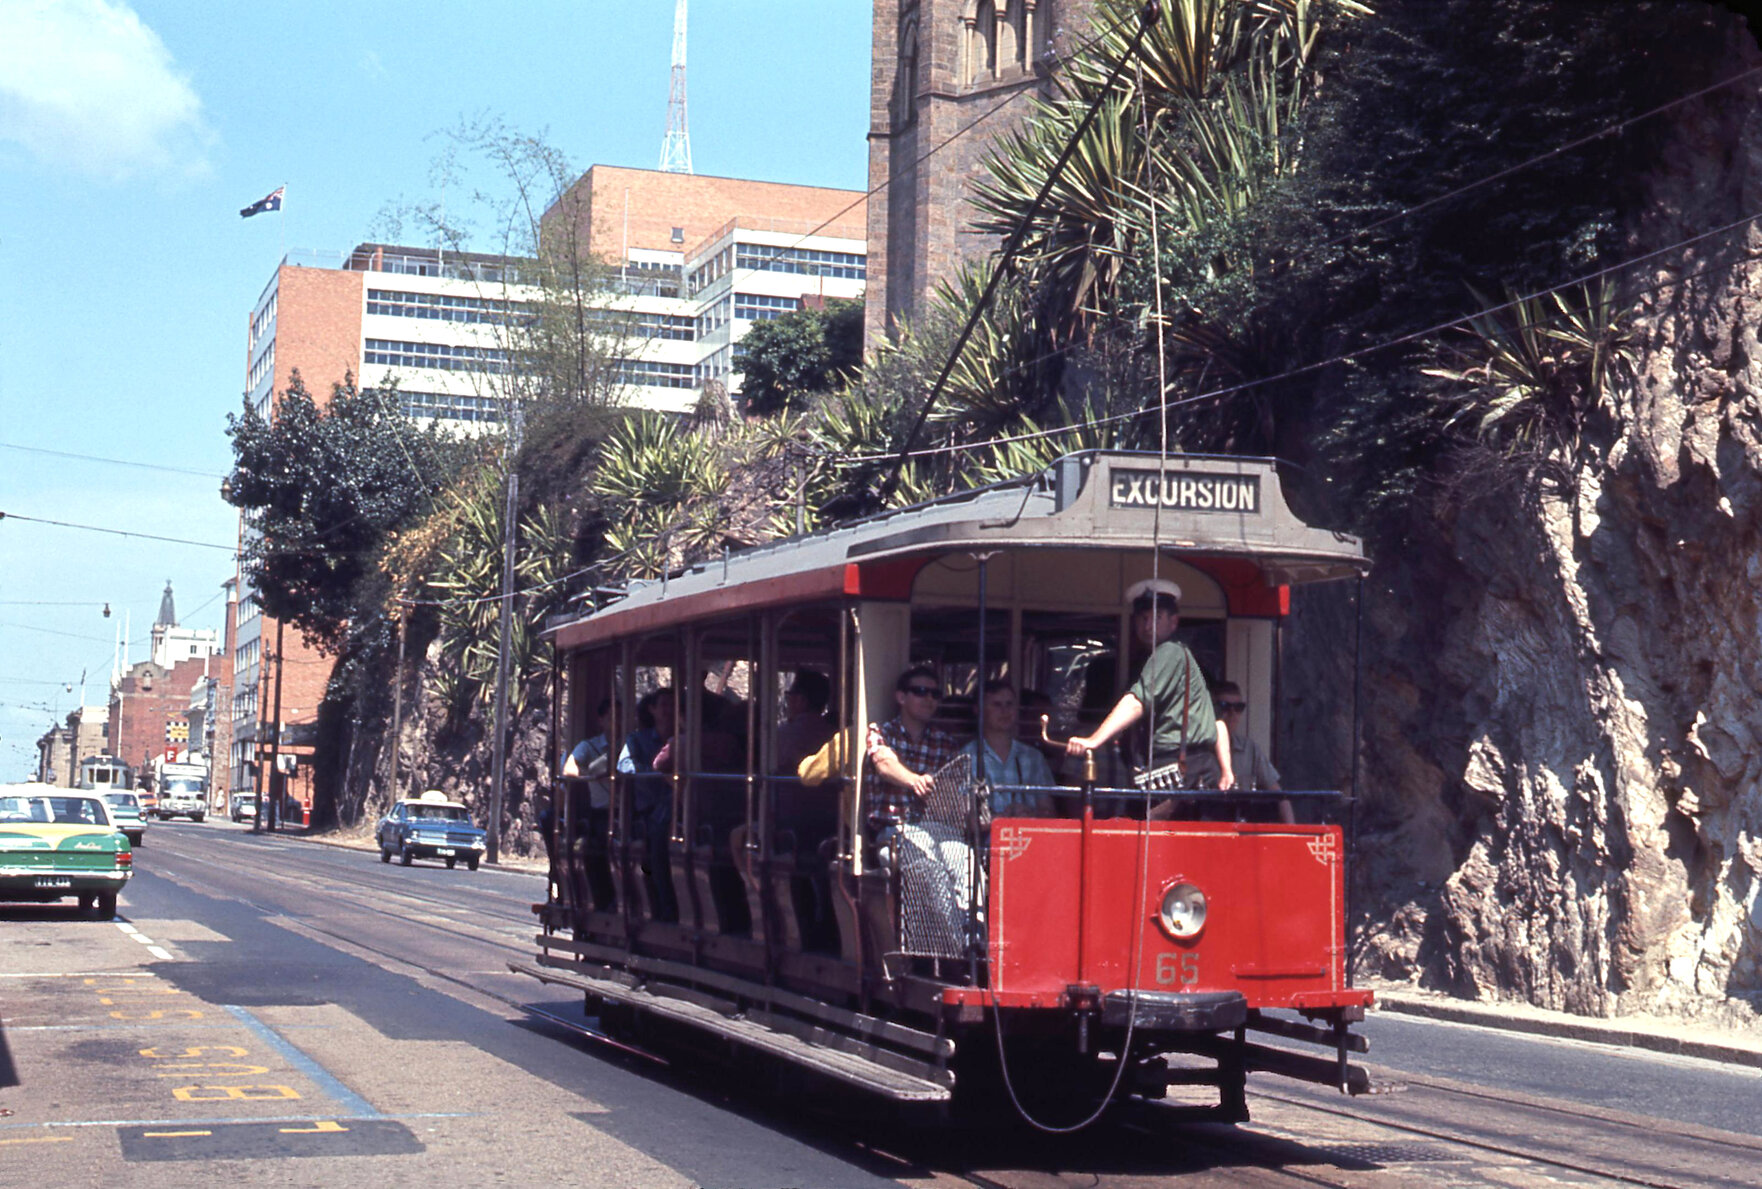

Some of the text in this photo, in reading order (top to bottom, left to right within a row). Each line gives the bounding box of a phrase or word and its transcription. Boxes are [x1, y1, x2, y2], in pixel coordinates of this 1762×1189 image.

[1112, 474, 1254, 510] EXCURSION
[1156, 952, 1199, 985] 65
[138, 1046, 301, 1101] BUS
